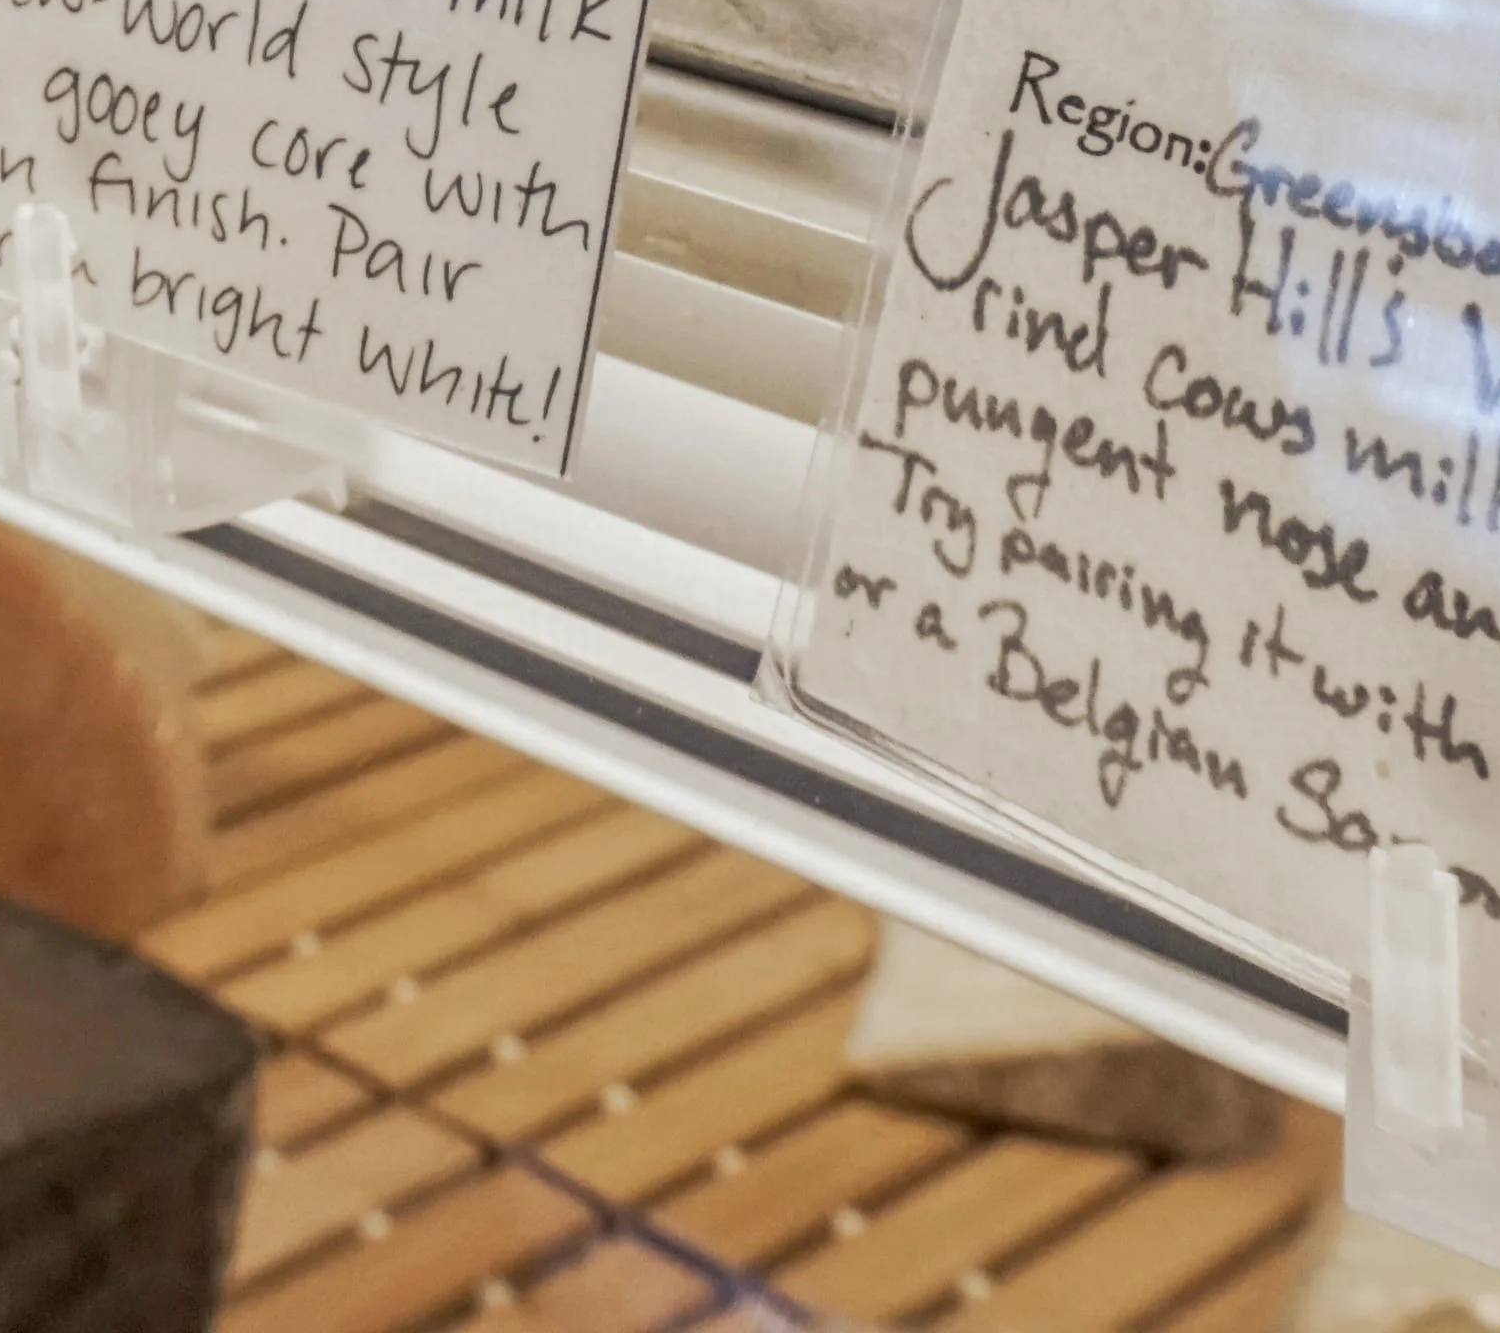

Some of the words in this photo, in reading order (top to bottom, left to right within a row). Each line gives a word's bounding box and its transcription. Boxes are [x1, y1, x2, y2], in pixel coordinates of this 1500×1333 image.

[42, 65, 207, 183] gooey
[251, 118, 376, 191] core
[423, 161, 591, 251] with
[342, 30, 522, 161] style
[1009, 49, 1212, 174] Region:
[86, 151, 290, 251] finish.
[327, 202, 483, 301] Pair
[903, 128, 1209, 291] Jasper
[131, 246, 323, 362] bright
[358, 324, 562, 444] white!
[972, 276, 1112, 379] rind
[893, 358, 1178, 523] pungent
[1217, 478, 1380, 605] nose
[833, 563, 898, 608] or
[914, 602, 959, 652] a
[976, 598, 1249, 810] Belgian
[858, 428, 980, 579] Try
[1000, 528, 1211, 705] pairing
[1239, 603, 1305, 677] it
[1312, 664, 1490, 780] with
